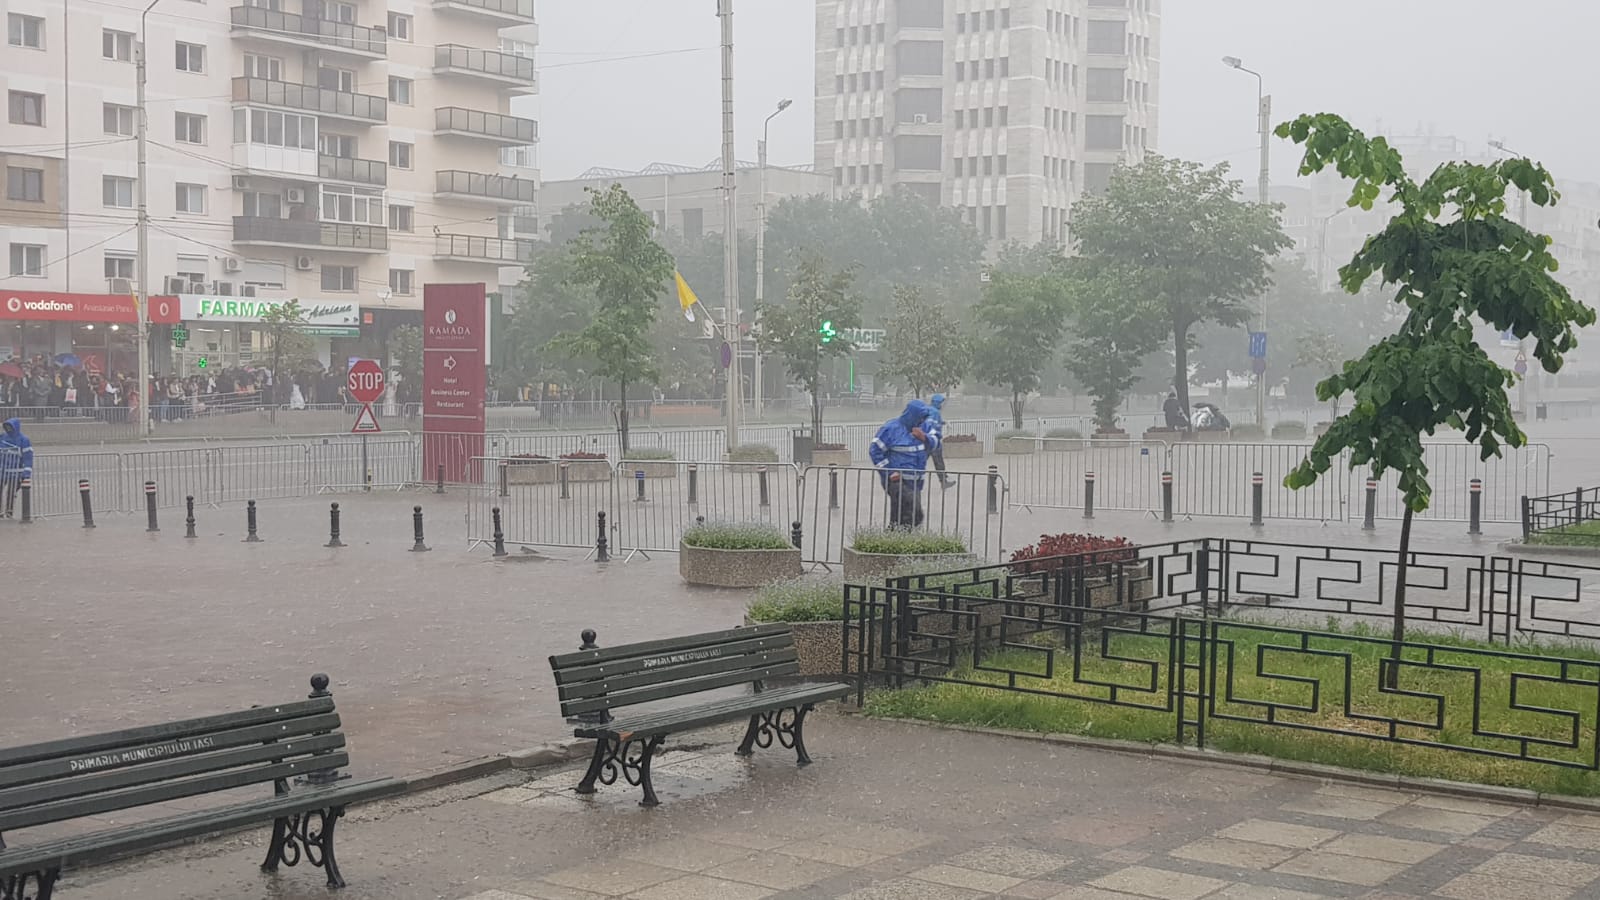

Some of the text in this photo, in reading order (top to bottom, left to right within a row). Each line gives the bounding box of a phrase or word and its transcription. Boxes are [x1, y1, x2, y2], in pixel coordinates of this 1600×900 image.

[24, 300, 73, 311] vodafone
[429, 326, 471, 335] RAMADA
[349, 372, 383, 390] STOP
[436, 400, 465, 408] Restaurant
[70, 755, 120, 770] PRIMARIA
[193, 737, 215, 749] IASI
